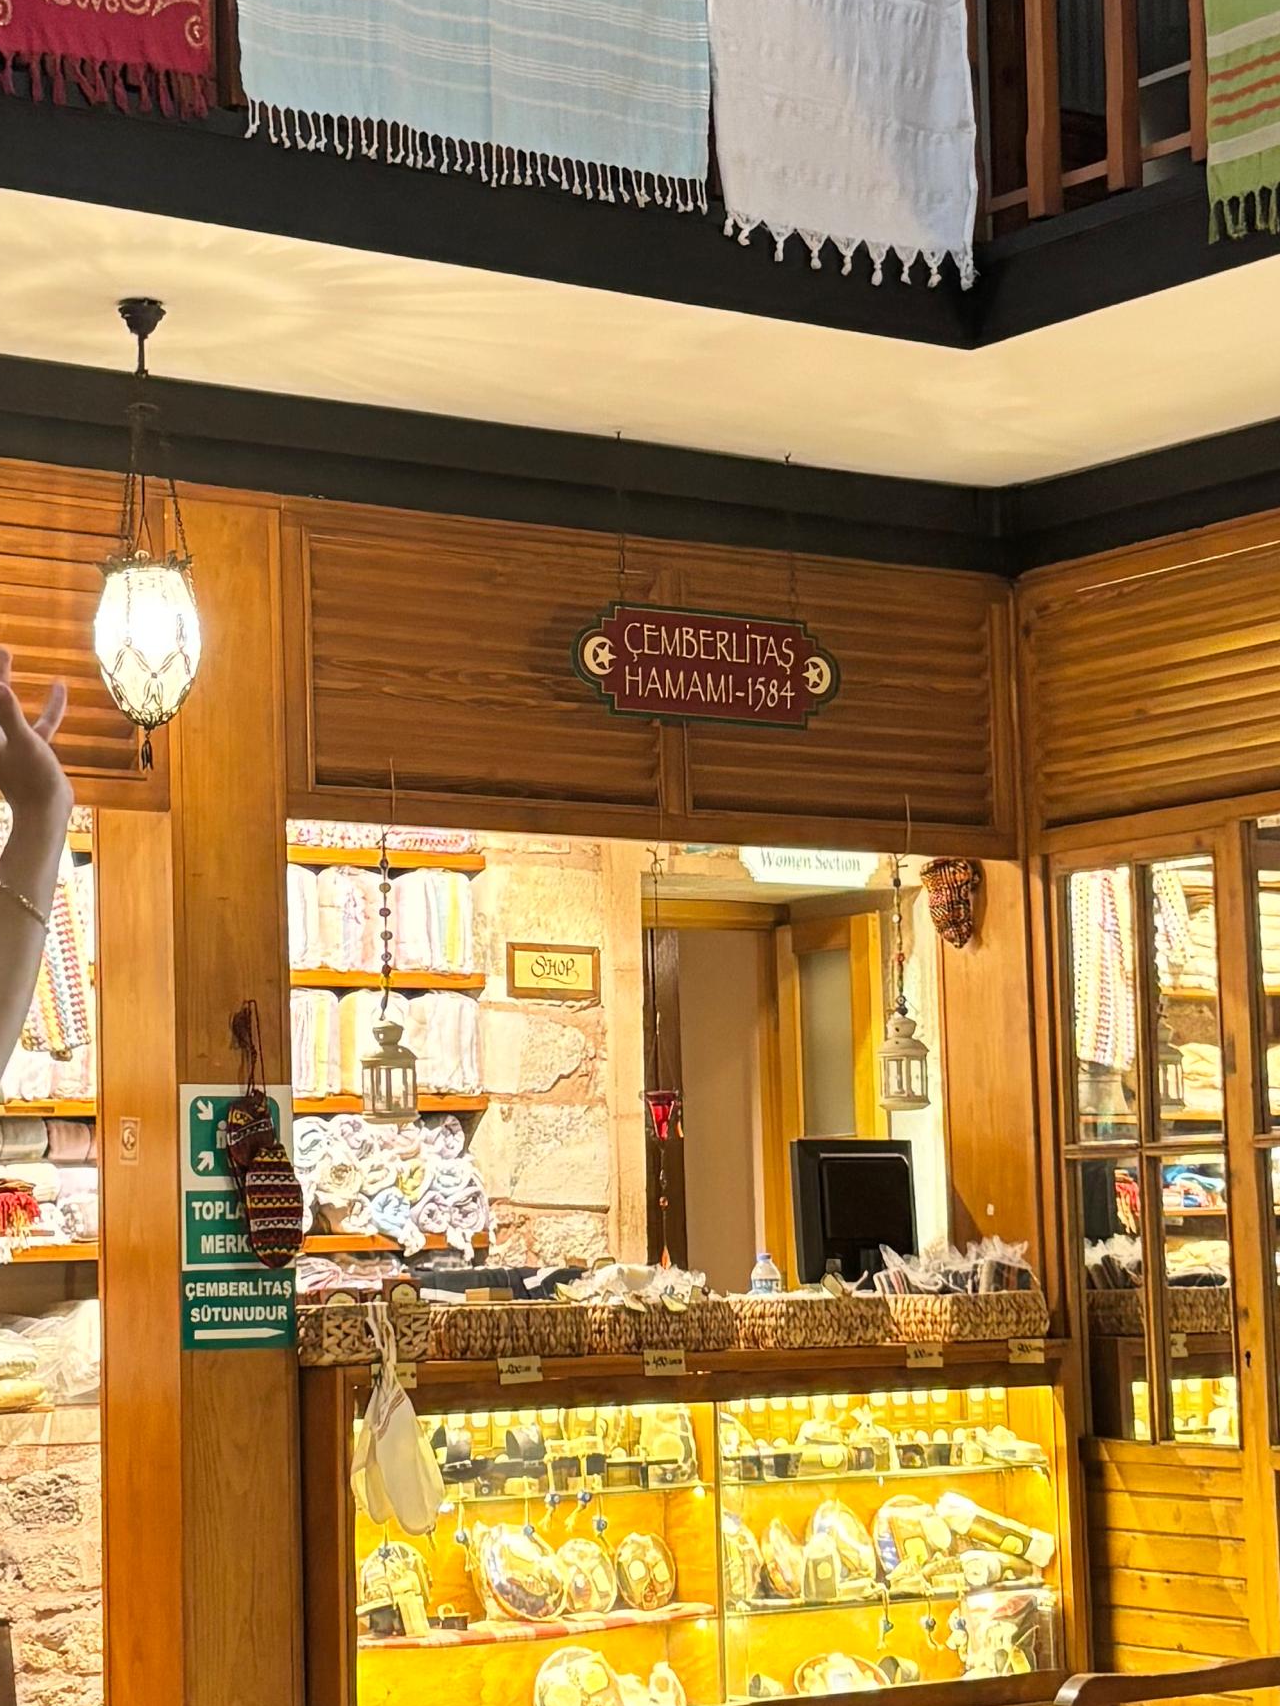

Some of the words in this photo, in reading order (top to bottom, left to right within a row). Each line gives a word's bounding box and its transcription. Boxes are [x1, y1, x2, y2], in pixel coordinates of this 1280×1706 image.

[623, 622, 795, 675] ÇEMBERLİTAŞ
[760, 847, 812, 870] Women
[815, 852, 862, 872] Section
[185, 1278, 292, 1301] ÇEMBERLİTAŞ
[190, 1305, 288, 1323] SÜTUNUDUR
